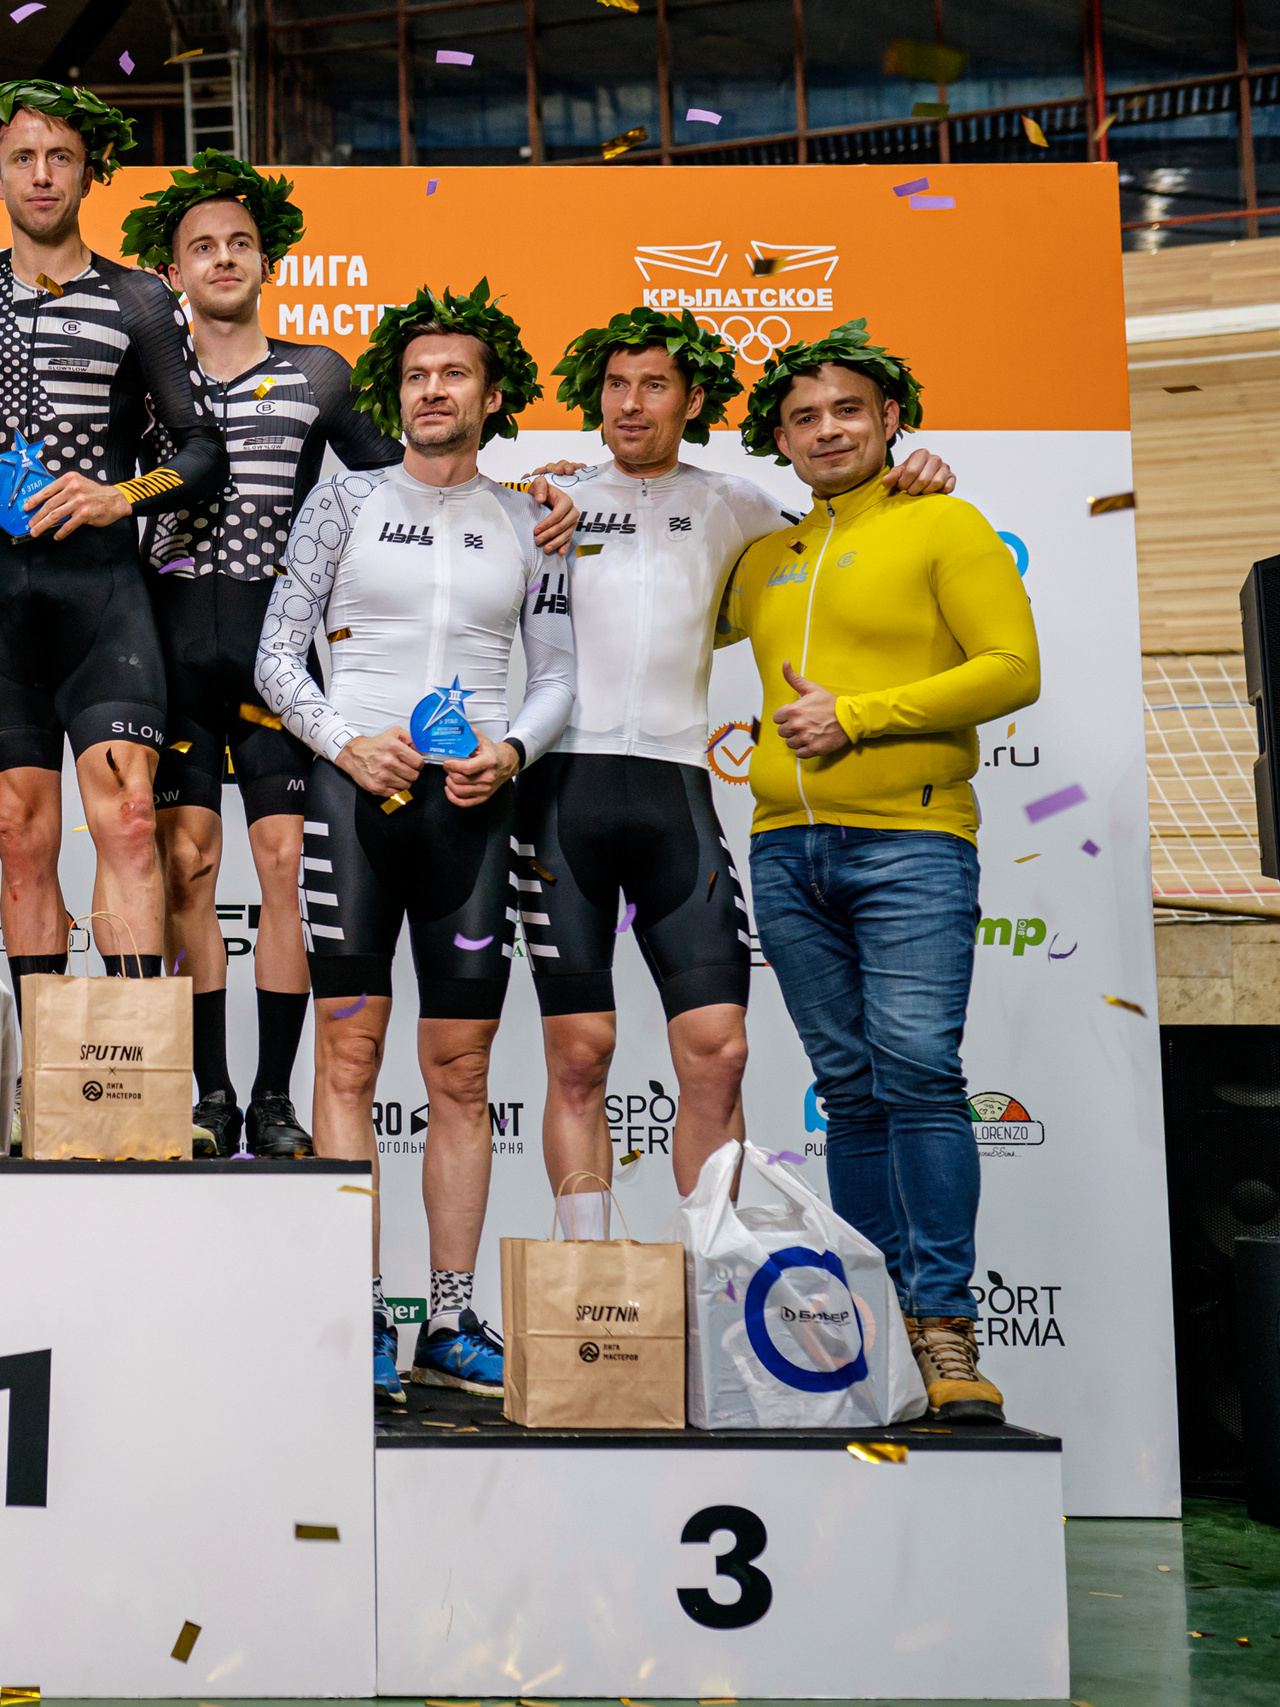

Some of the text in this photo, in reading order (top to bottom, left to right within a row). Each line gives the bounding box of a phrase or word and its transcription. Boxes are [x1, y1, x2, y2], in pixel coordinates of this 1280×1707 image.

[276, 255, 368, 287] ЛИГА
[643, 288, 833, 307] КРЫЛАТСКОЕ
[279, 303, 410, 336] МАСТ
[111, 721, 165, 746] SLOW
[80, 1044, 144, 1062] SPUTNIK
[106, 1082, 124, 1090] ЛИГА
[106, 1092, 142, 1100] МАСТЕРОВ
[968, 1286, 1062, 1315] PORT
[576, 1305, 639, 1322] SPUTNIK
[603, 1353, 639, 1361] МАСТЕРОВ
[676, 1504, 772, 1630] 3
